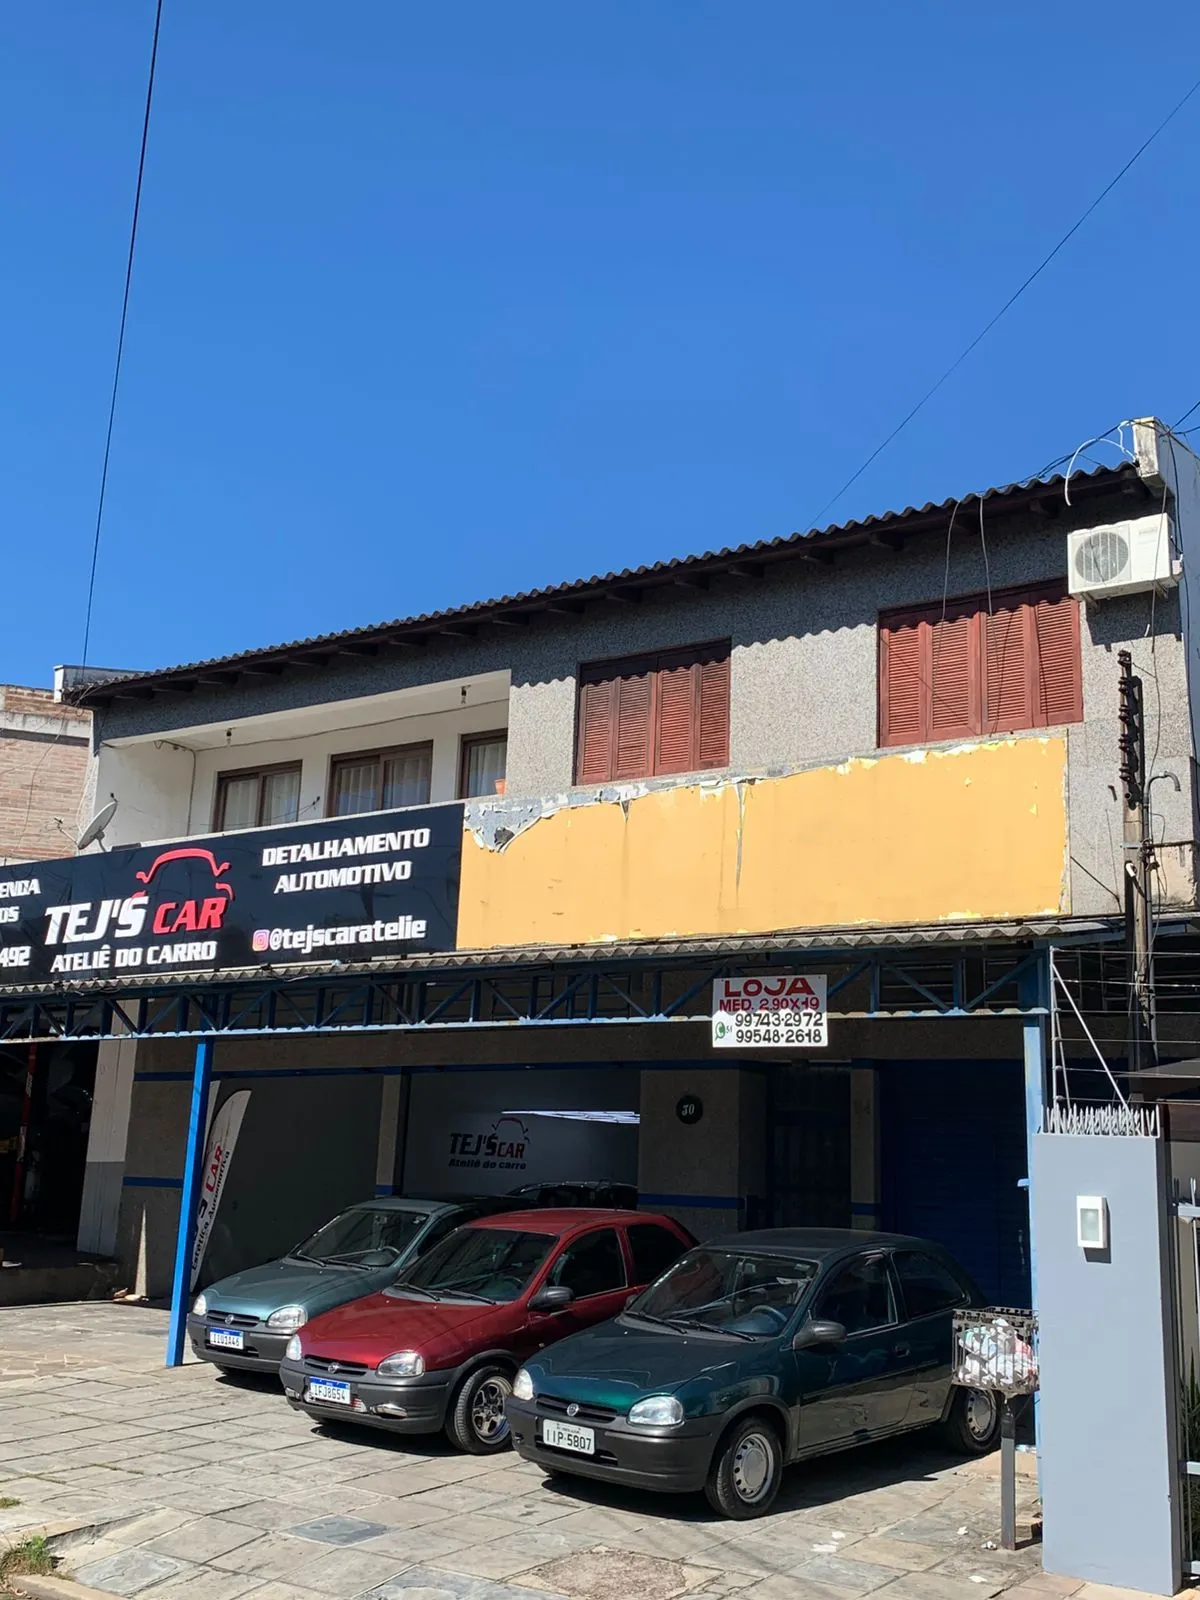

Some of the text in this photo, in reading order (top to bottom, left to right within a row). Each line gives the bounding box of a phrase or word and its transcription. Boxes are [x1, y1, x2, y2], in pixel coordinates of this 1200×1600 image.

[262, 828, 430, 867] DETALHAMENTO
[273, 861, 412, 895] AUTOMOTIVO
[44, 896, 228, 946] TEJ'S CAR
[269, 915, 427, 954] @tejscaratelie
[50, 941, 218, 973] ATELIÊ DO CARRO
[724, 977, 815, 997] LOJA
[719, 998, 755, 1012] MED.
[450, 1133, 525, 1158] TEJ'S CAR
[205, 1144, 224, 1193] CAR
[499, 1160, 527, 1170] carro
